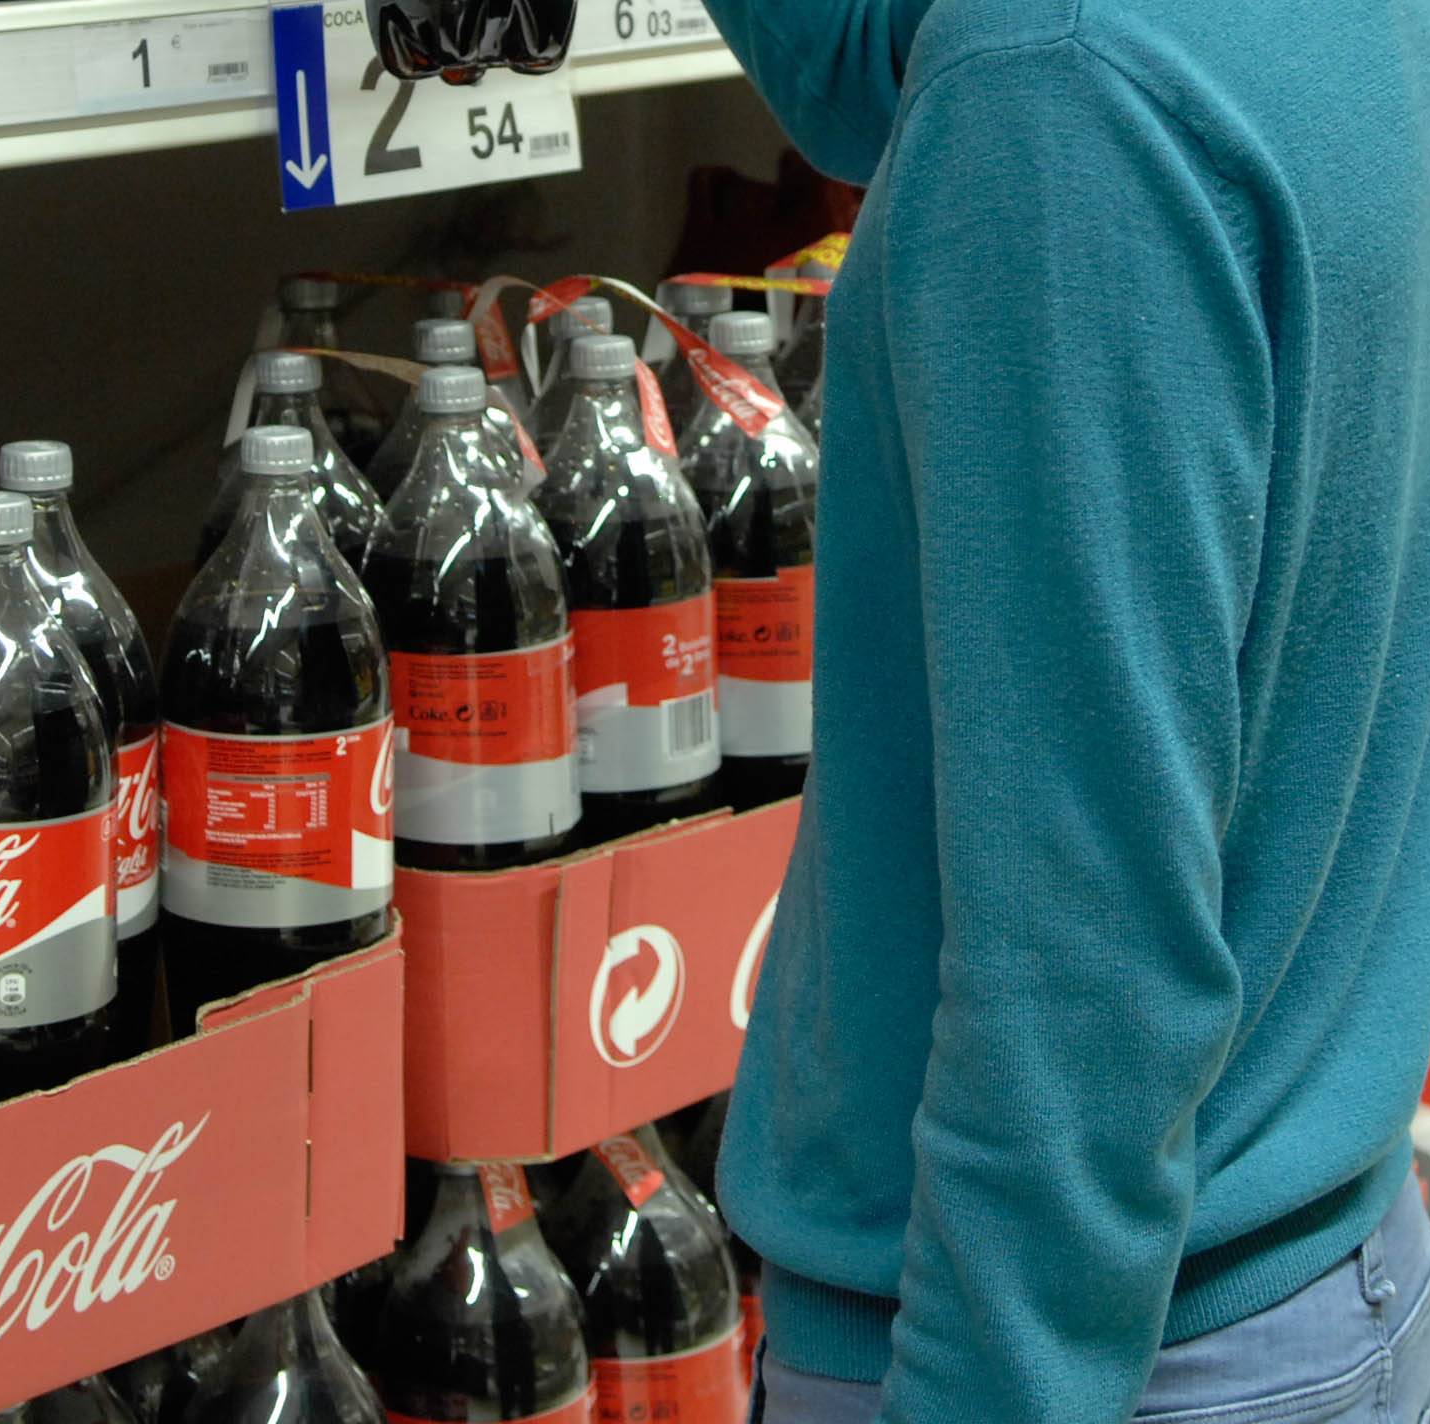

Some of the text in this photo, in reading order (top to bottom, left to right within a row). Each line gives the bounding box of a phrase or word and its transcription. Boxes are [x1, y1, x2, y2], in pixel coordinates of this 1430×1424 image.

[323, 8, 364, 29] COCA
[647, 9, 672, 38] 03
[131, 38, 151, 88] 1
[467, 101, 523, 161] 54
[661, 633, 677, 658] 2
[335, 735, 348, 758] 2
